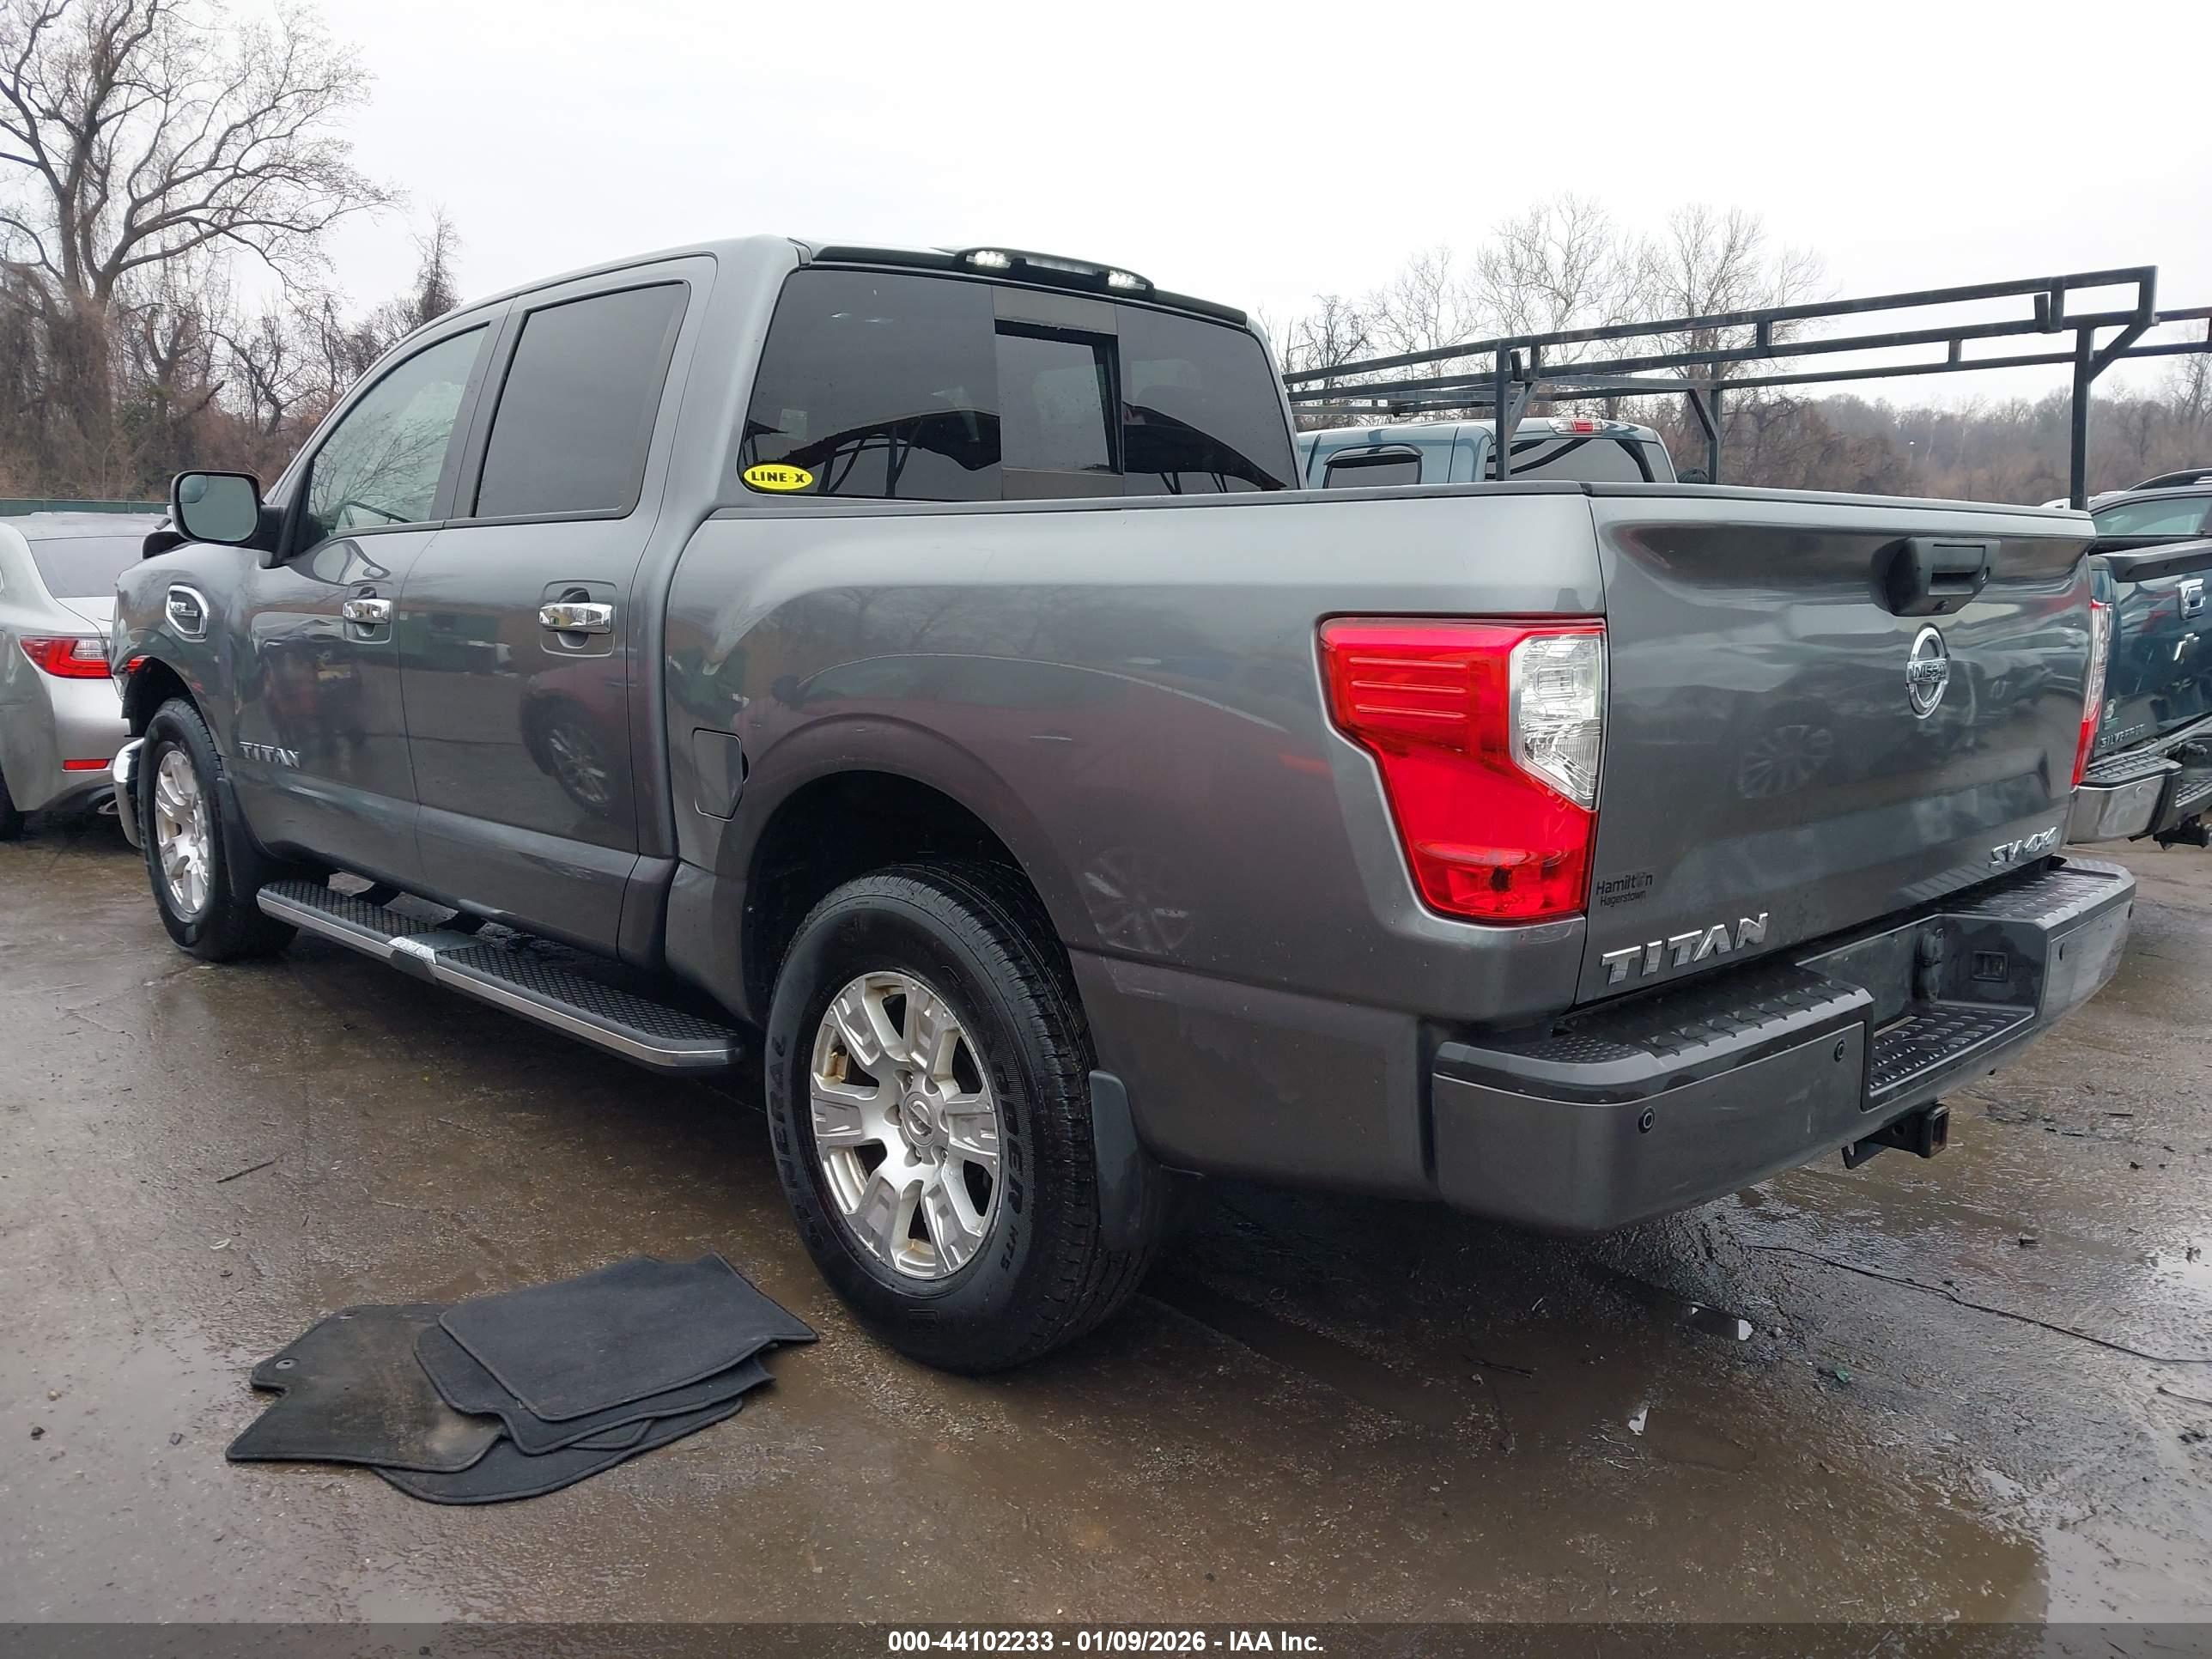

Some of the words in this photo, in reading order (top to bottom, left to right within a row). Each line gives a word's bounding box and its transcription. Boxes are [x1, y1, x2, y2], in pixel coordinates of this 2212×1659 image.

[750, 470, 806, 483] LINE-X
[239, 741, 302, 769] TITAN
[1987, 842, 2023, 868] SV
[1600, 890, 1647, 908] Hagerstown
[1601, 912, 1770, 986] TITAN
